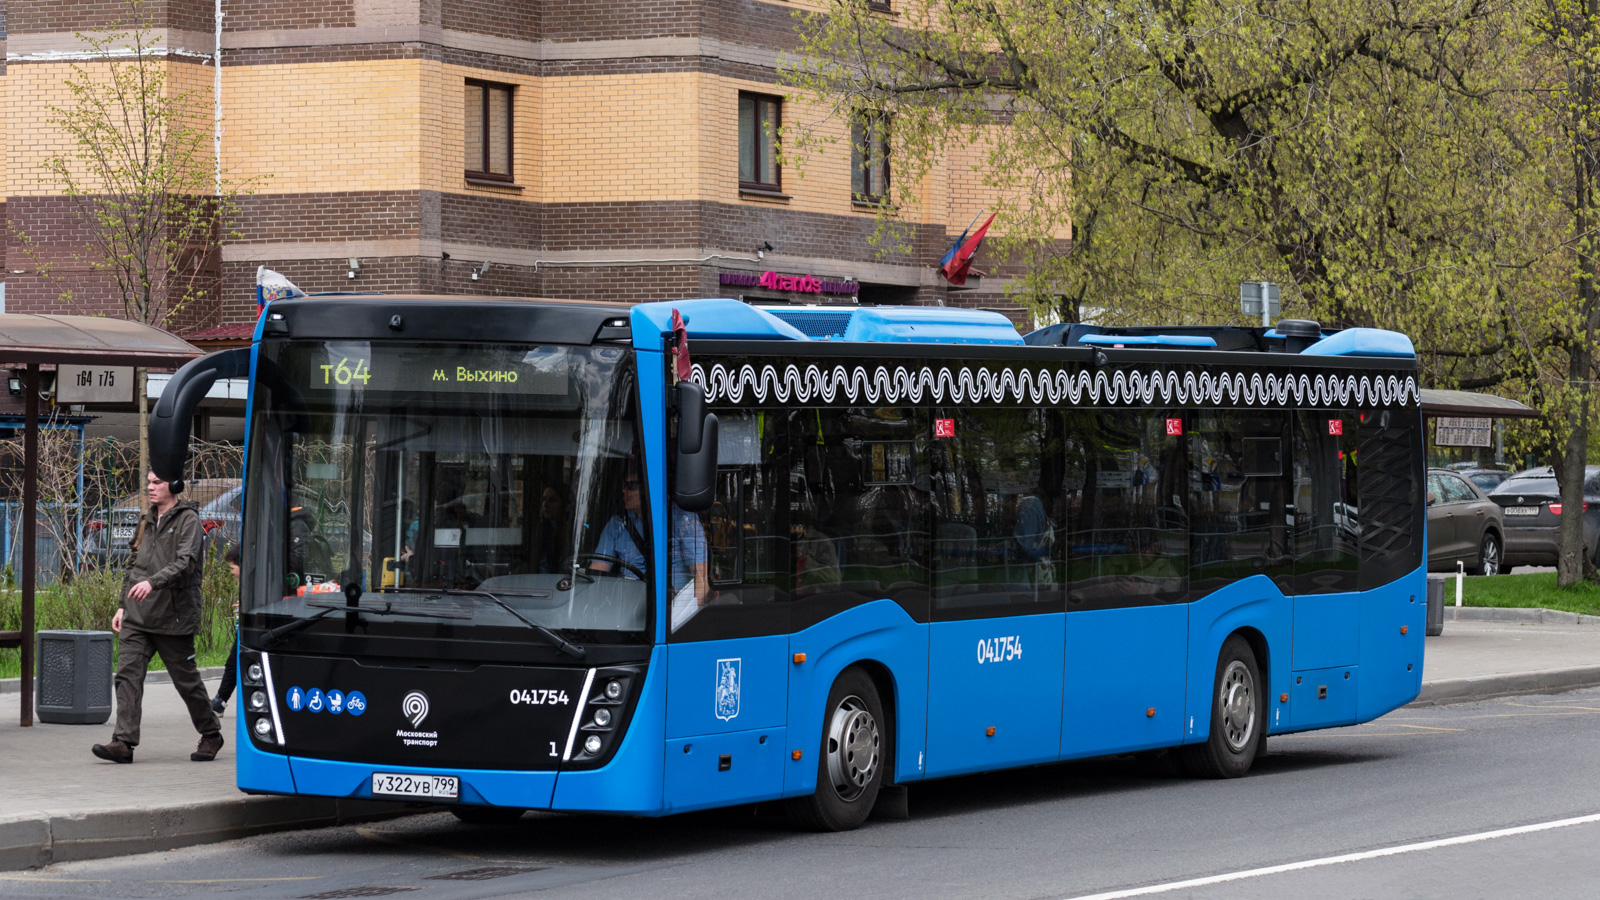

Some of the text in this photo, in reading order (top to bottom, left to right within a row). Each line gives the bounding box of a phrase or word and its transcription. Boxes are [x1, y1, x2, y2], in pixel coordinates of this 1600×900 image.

[760, 271, 822, 293] 4hands
[456, 366, 518, 383] Выхино
[977, 635, 1023, 665] 041754
[509, 689, 570, 706] 041754
[396, 729, 438, 739] Московский
[403, 738, 438, 748] транспорт
[548, 741, 559, 757] 1
[433, 777, 455, 791] 799
